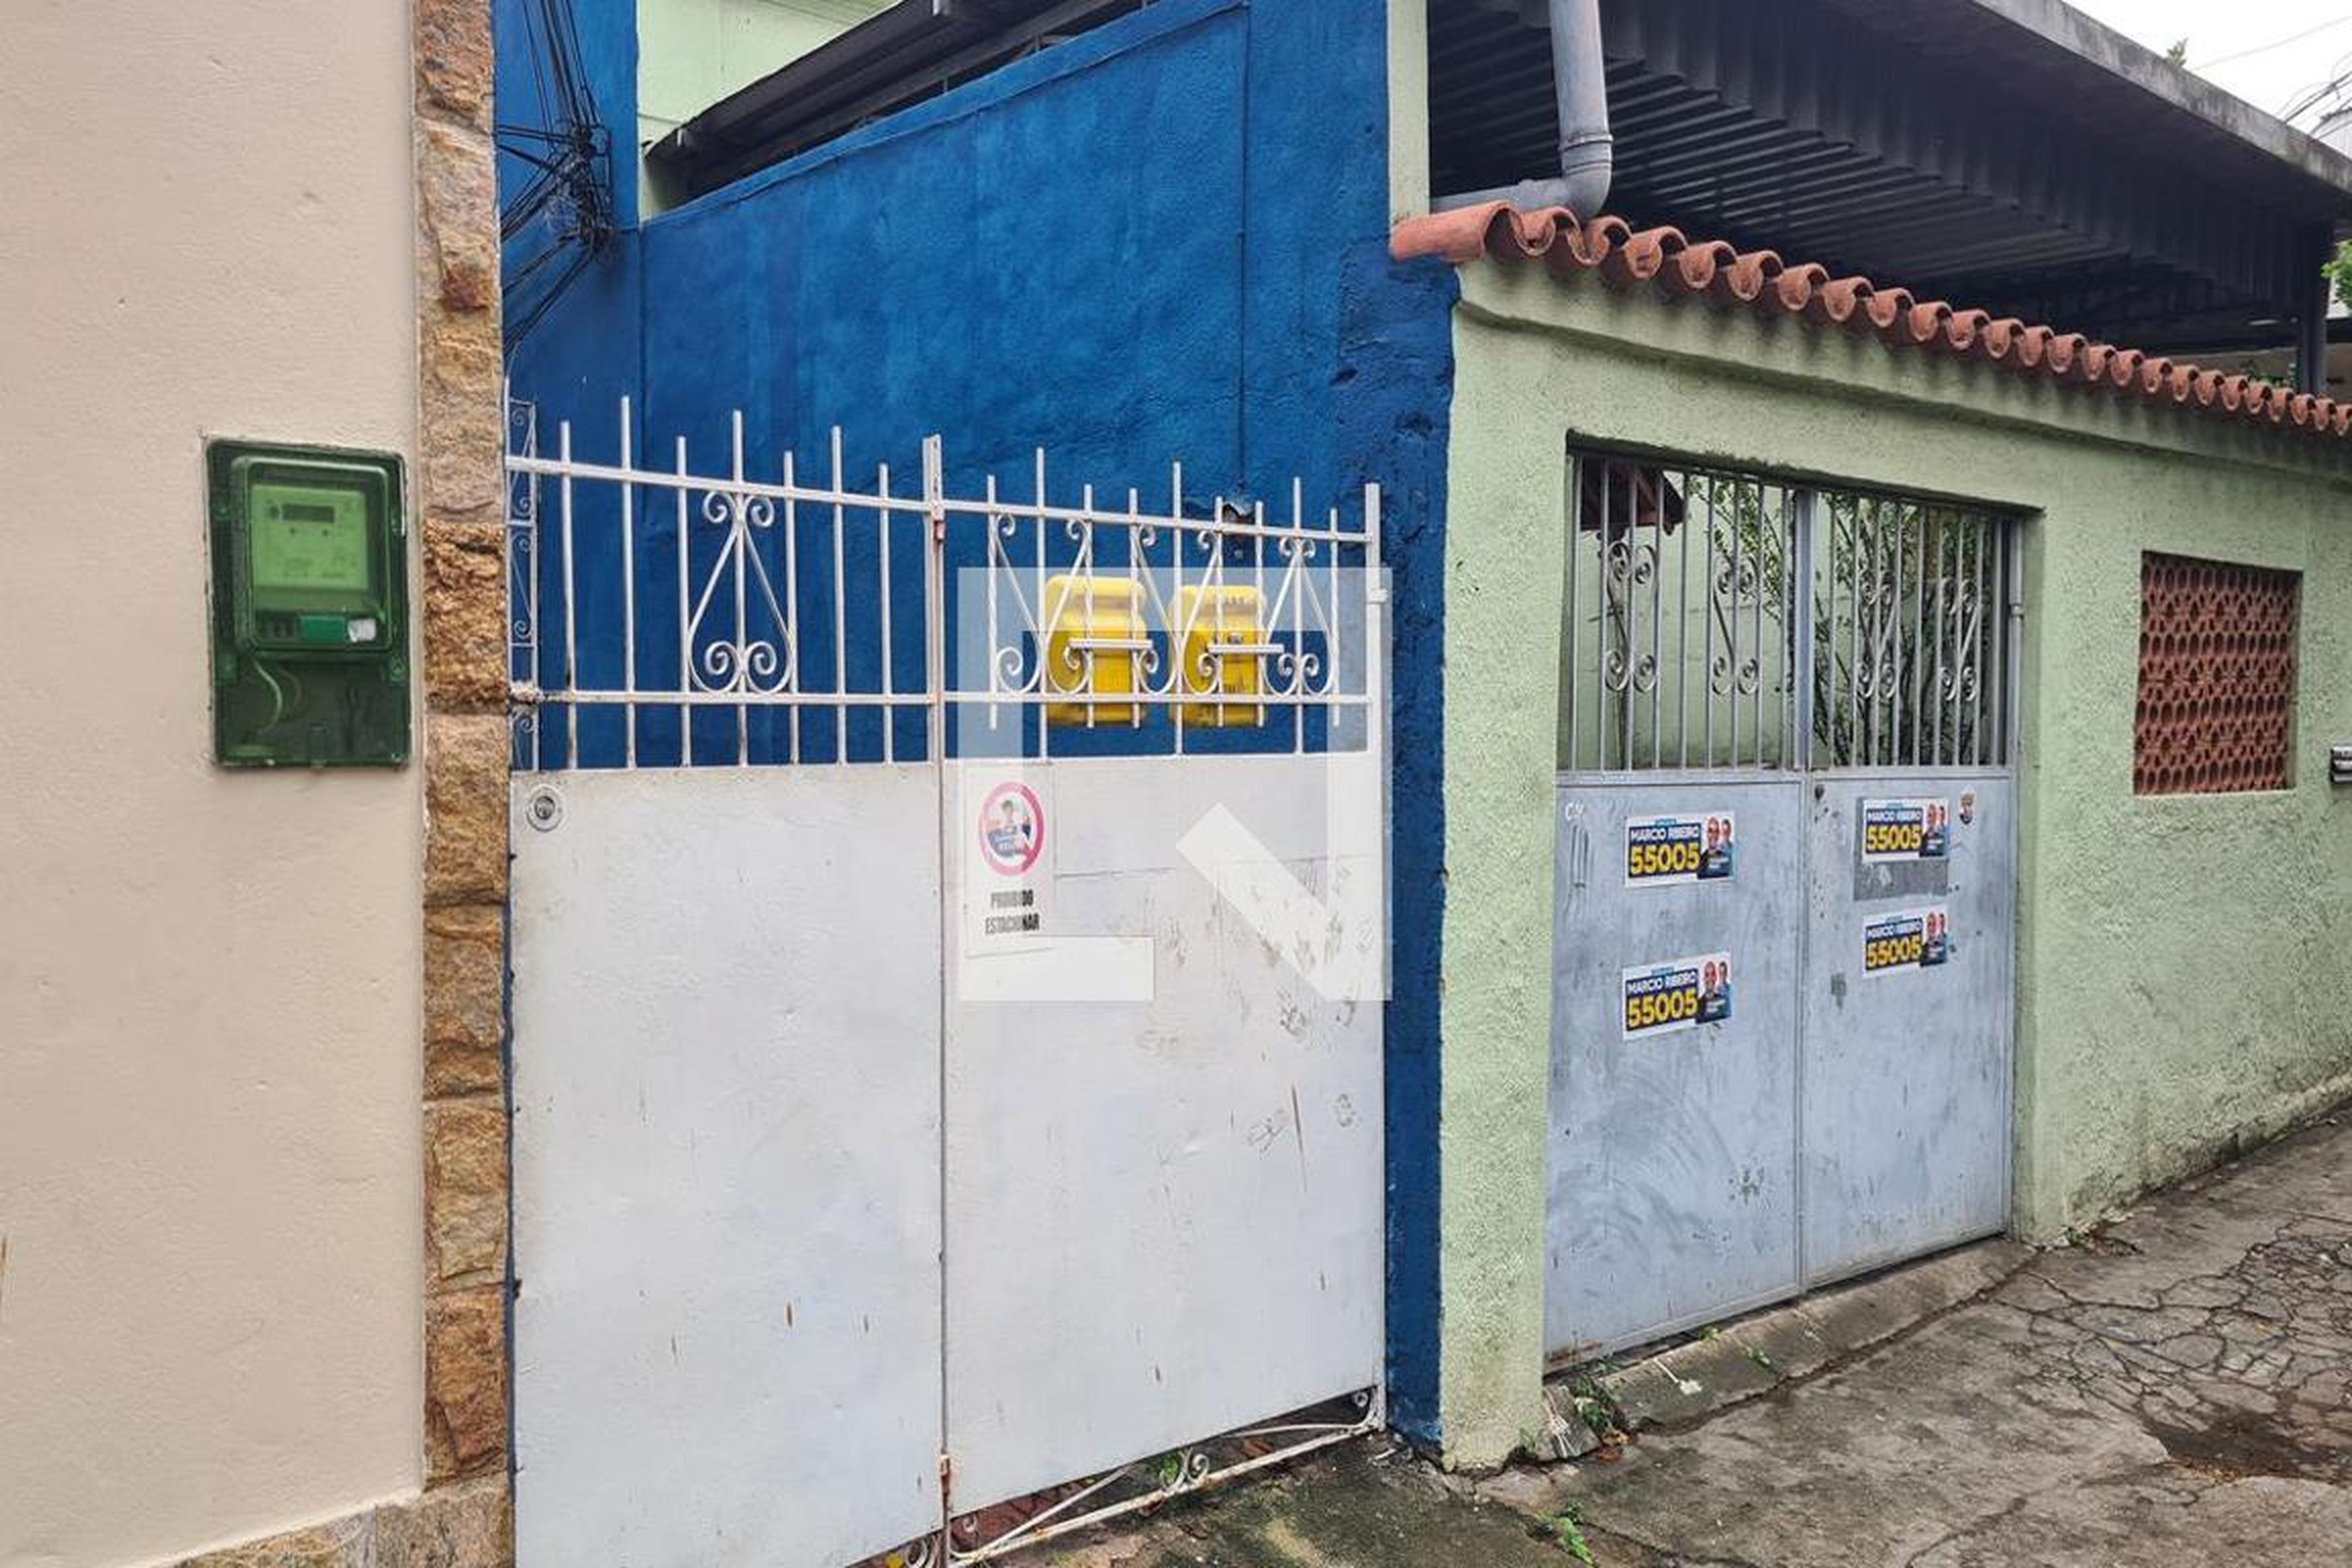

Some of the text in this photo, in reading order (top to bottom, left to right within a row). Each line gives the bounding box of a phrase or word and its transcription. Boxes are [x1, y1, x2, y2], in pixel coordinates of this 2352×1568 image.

[1868, 825, 1921, 851] 55005
[1630, 843, 1700, 875] 55005
[1868, 935, 1921, 967] 55005
[1629, 988, 1698, 1028] 55005
